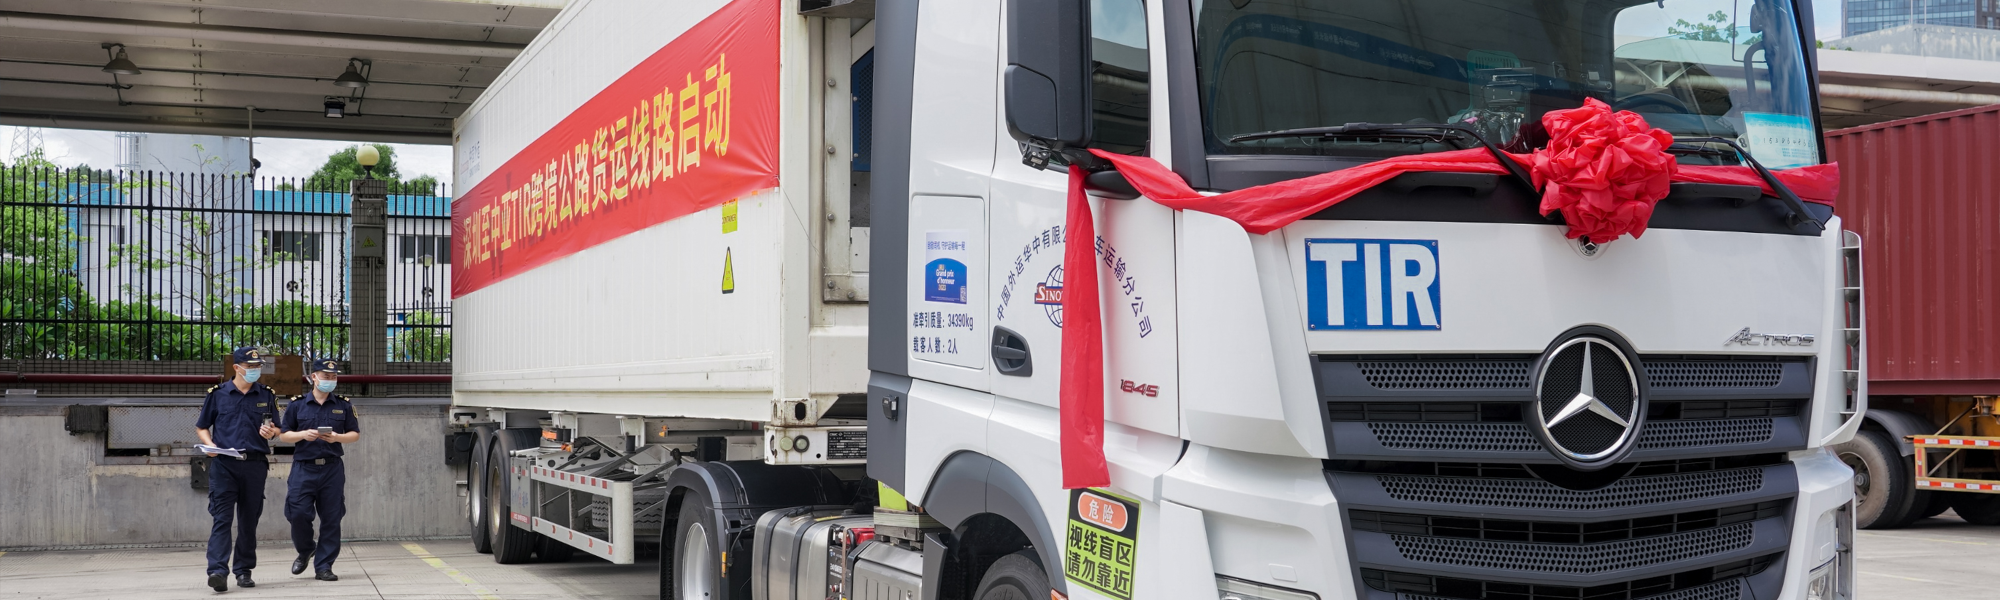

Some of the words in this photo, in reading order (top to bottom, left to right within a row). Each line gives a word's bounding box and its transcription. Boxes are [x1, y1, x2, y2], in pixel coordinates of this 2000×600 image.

[463, 53, 731, 269] 深圳至中亚TIR跨境公路货运线路启动
[1036, 285, 1064, 302] SINO
[1310, 242, 1438, 326] TIR
[1121, 379, 1160, 398] 1845
[1088, 499, 1114, 524] 危险
[1069, 523, 1132, 567] 视线盲区
[1068, 550, 1130, 596] 请勿靠近
